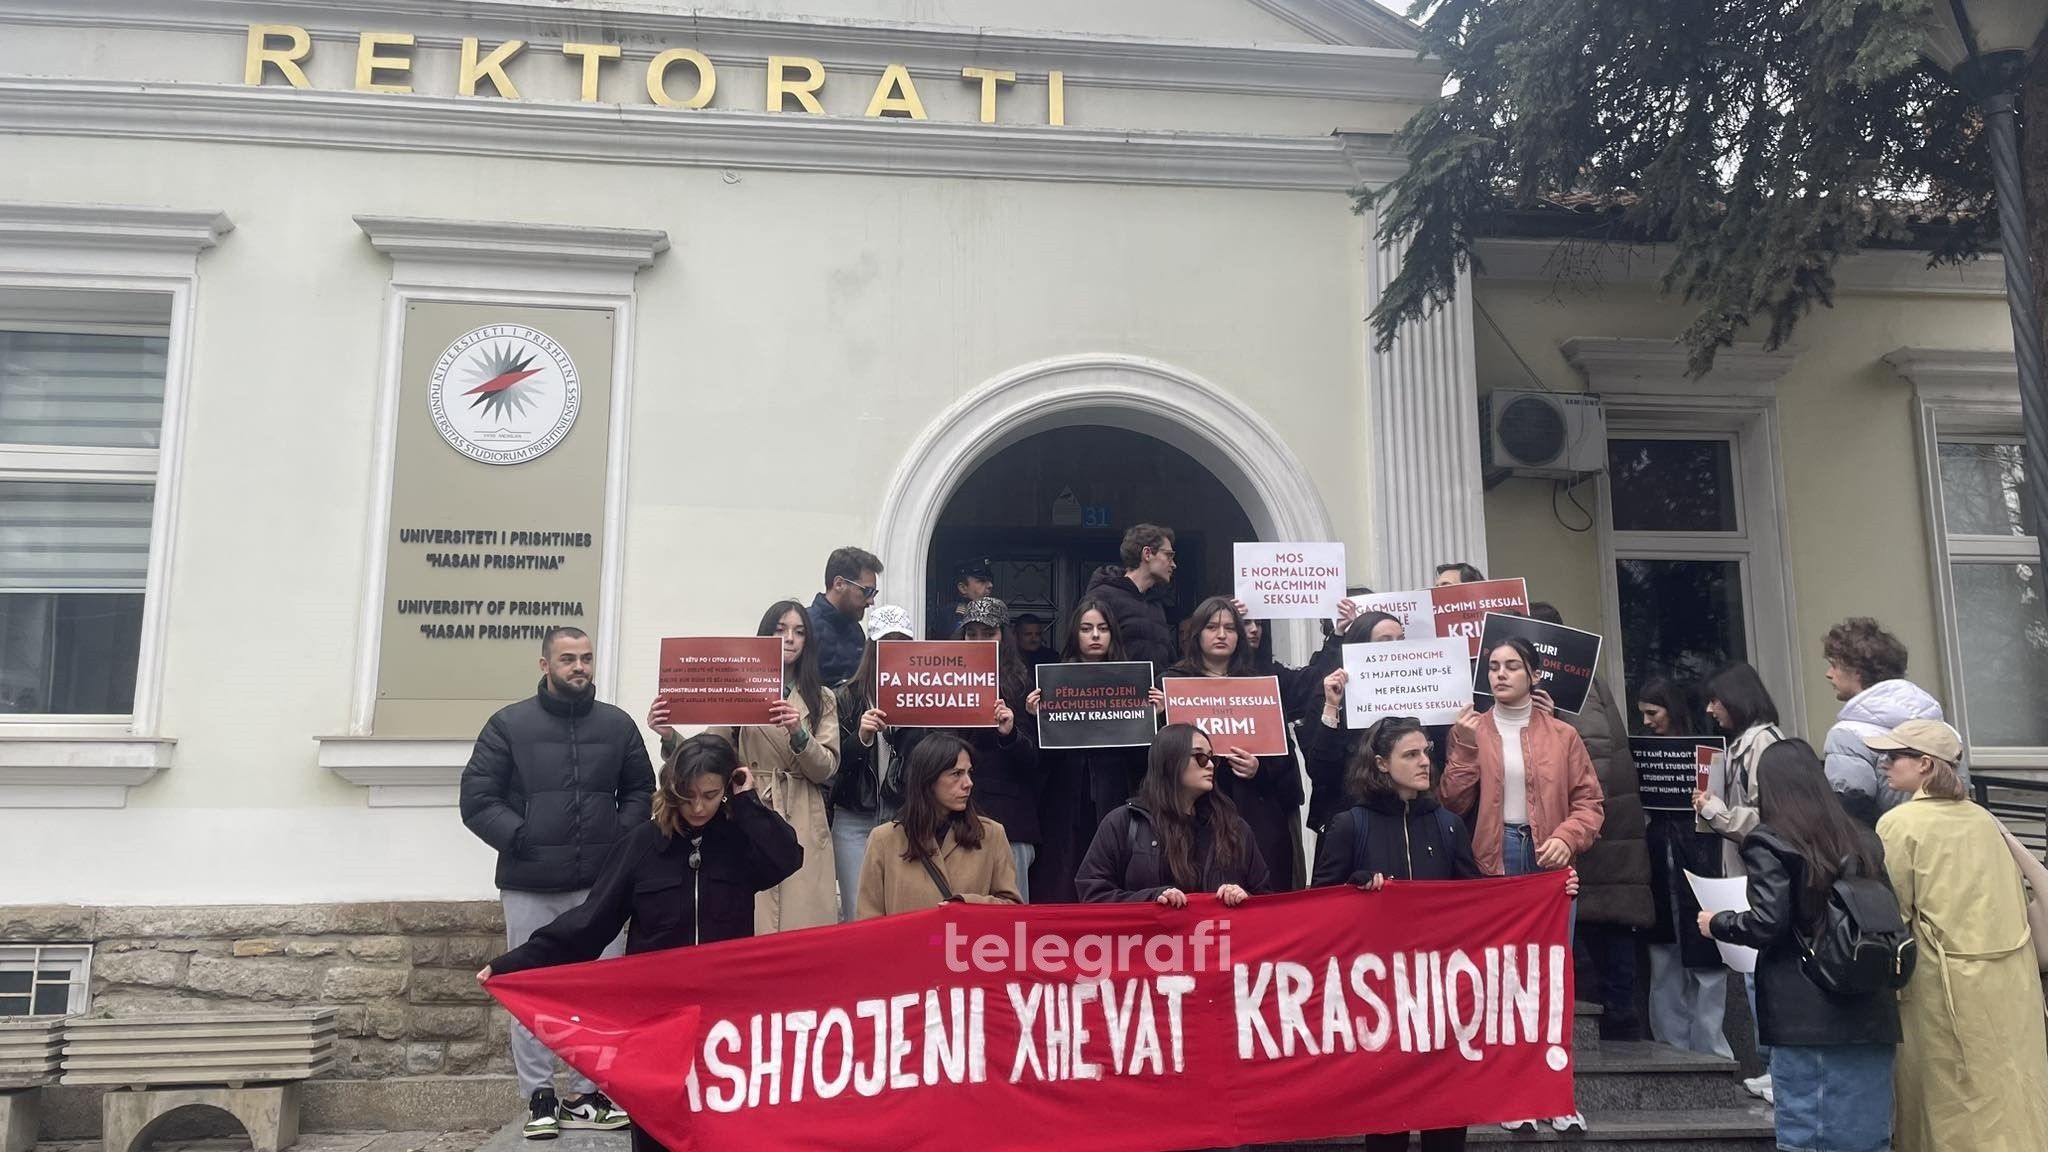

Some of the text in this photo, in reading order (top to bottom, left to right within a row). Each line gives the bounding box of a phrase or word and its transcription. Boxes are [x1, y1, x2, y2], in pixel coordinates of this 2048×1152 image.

[243, 24, 1064, 127] REKTORATI
[431, 327, 504, 389] UNIVERSITETI
[524, 331, 576, 394] PRISHTINES
[431, 391, 465, 448] UNIVERSITAS
[464, 444, 528, 461] STUDIORUM
[1086, 507, 1108, 526] 31
[400, 528, 592, 547] UNIVERSITETI I PRISHTINES
[1275, 553, 1304, 563] MOS
[1241, 567, 1339, 577] E NORMALIZONI
[1255, 580, 1327, 590] NGACMIMIN
[1263, 594, 1319, 604] SEKSUAL!
[398, 599, 584, 616] UNIVERSITY OF PRISHTINA
[1355, 601, 1418, 616] GACMUESIT
[1433, 597, 1524, 615] GACMIMI SEKSUAL
[909, 656, 967, 668] STUDIME,
[1365, 651, 1444, 663] AS 27 DENONCIME
[1373, 668, 1423, 679] MJAFTOJNË
[1425, 666, 1452, 676] UP-SË
[880, 672, 996, 687] PA NGACMIME
[1055, 686, 1136, 697] PËRJASHTOJENI
[1375, 684, 1439, 695] ME PËRJASHTU
[896, 693, 980, 708] SEKSUALE!
[1040, 698, 1152, 710] NGACMUESIN SEKSUA
[1169, 696, 1277, 707] NGACMIMI SEKSUAL
[1357, 700, 1463, 712] NJË NGACMUES SEKSUAL
[1048, 710, 1145, 722] XHEVAT KRASNIQIN!
[1196, 717, 1256, 735] KRIM!
[686, 987, 986, 1113] SHTOJENI
[1006, 974, 1196, 1085] XHEVAT
[1234, 943, 1568, 1071] KRASNIQIN!
